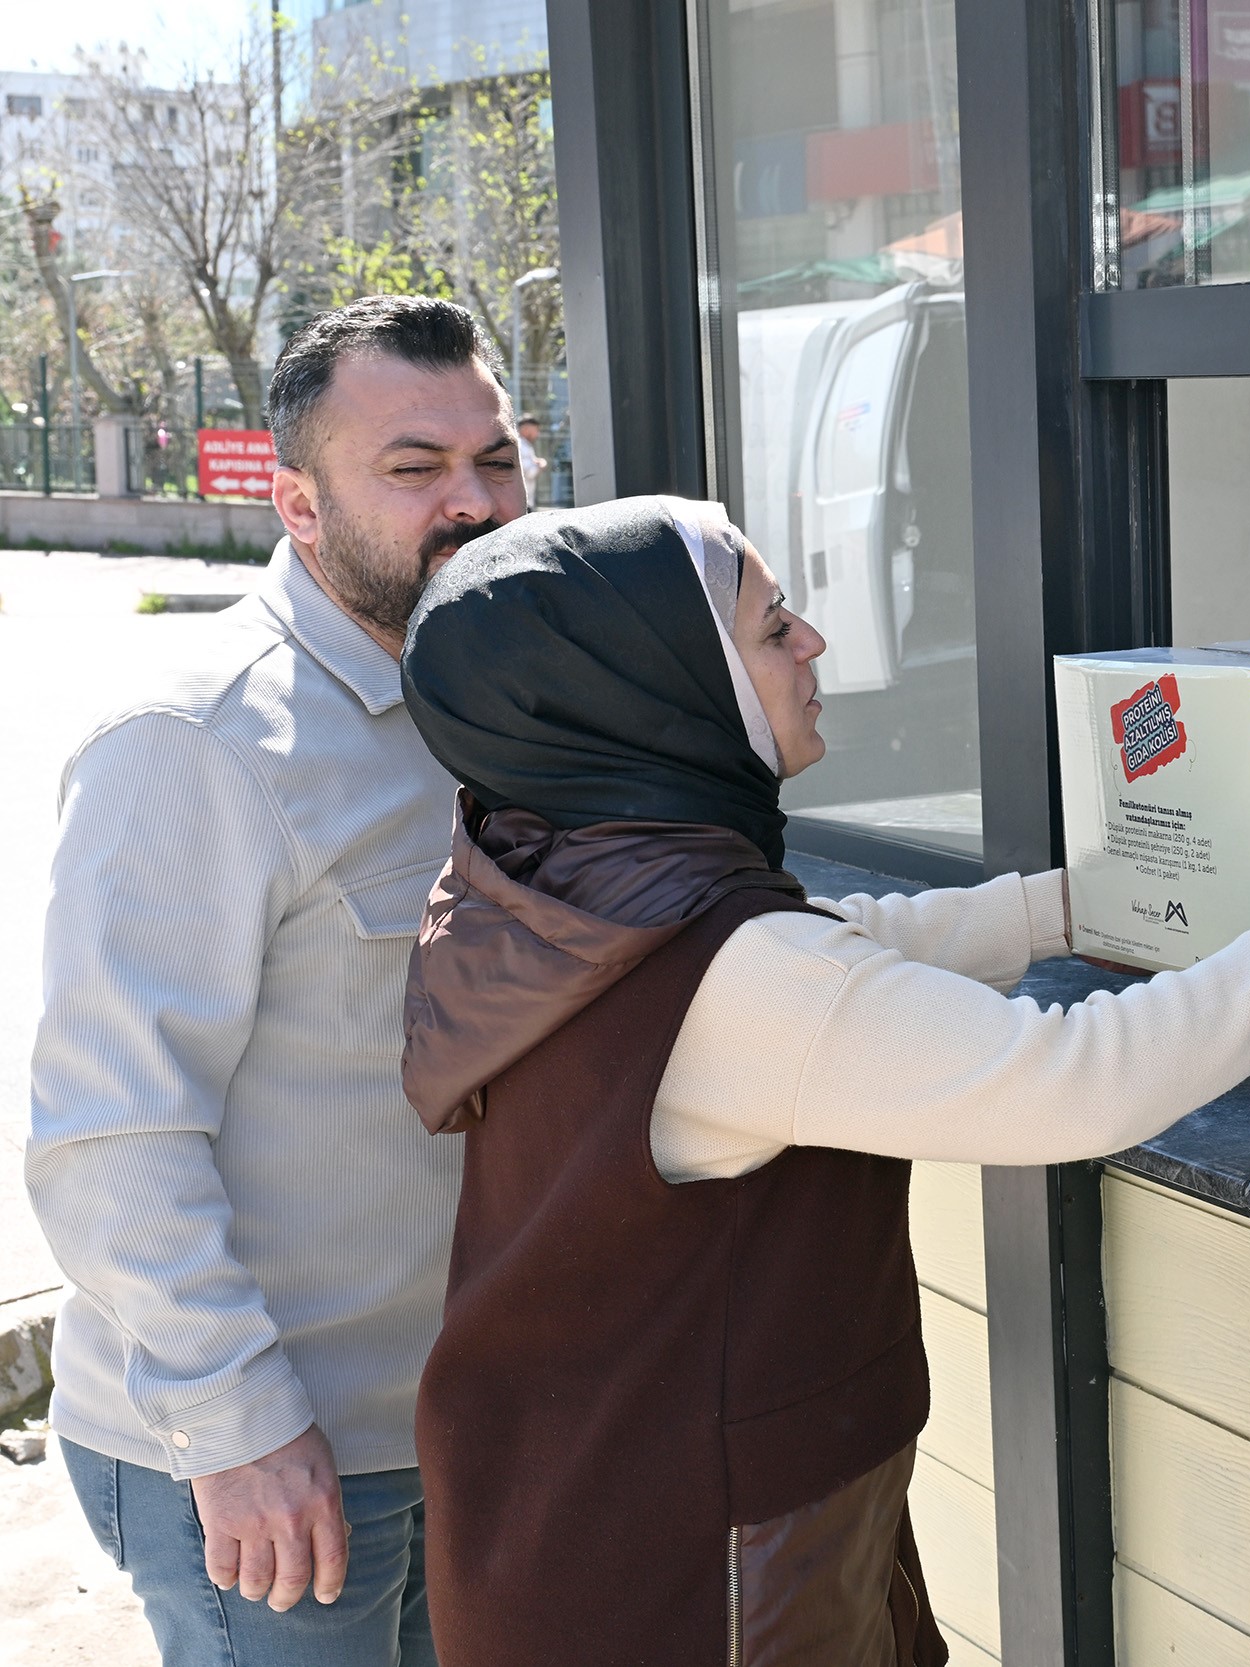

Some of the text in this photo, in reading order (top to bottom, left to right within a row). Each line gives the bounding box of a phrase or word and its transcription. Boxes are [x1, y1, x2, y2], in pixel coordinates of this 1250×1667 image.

[203, 439, 245, 454] ADLİYE
[246, 441, 271, 455] ANA
[208, 458, 263, 472] KAPISINA
[1123, 687, 1163, 728] PROTEİNİ
[1125, 706, 1171, 751] AZALTILMIŞ
[1128, 721, 1178, 769] GIDA KOLİSİ
[1119, 799, 1193, 821] Fenilketonüri tanısı almış
[1173, 833, 1185, 843] (250
[1192, 836, 1196, 844] 4
[1197, 838, 1213, 848] adet)
[1106, 845, 1121, 857] Genel
[1202, 865, 1218, 876] adet)
[1171, 845, 1184, 856] (250
[1191, 849, 1195, 858] 2
[1195, 850, 1211, 861] adet)
